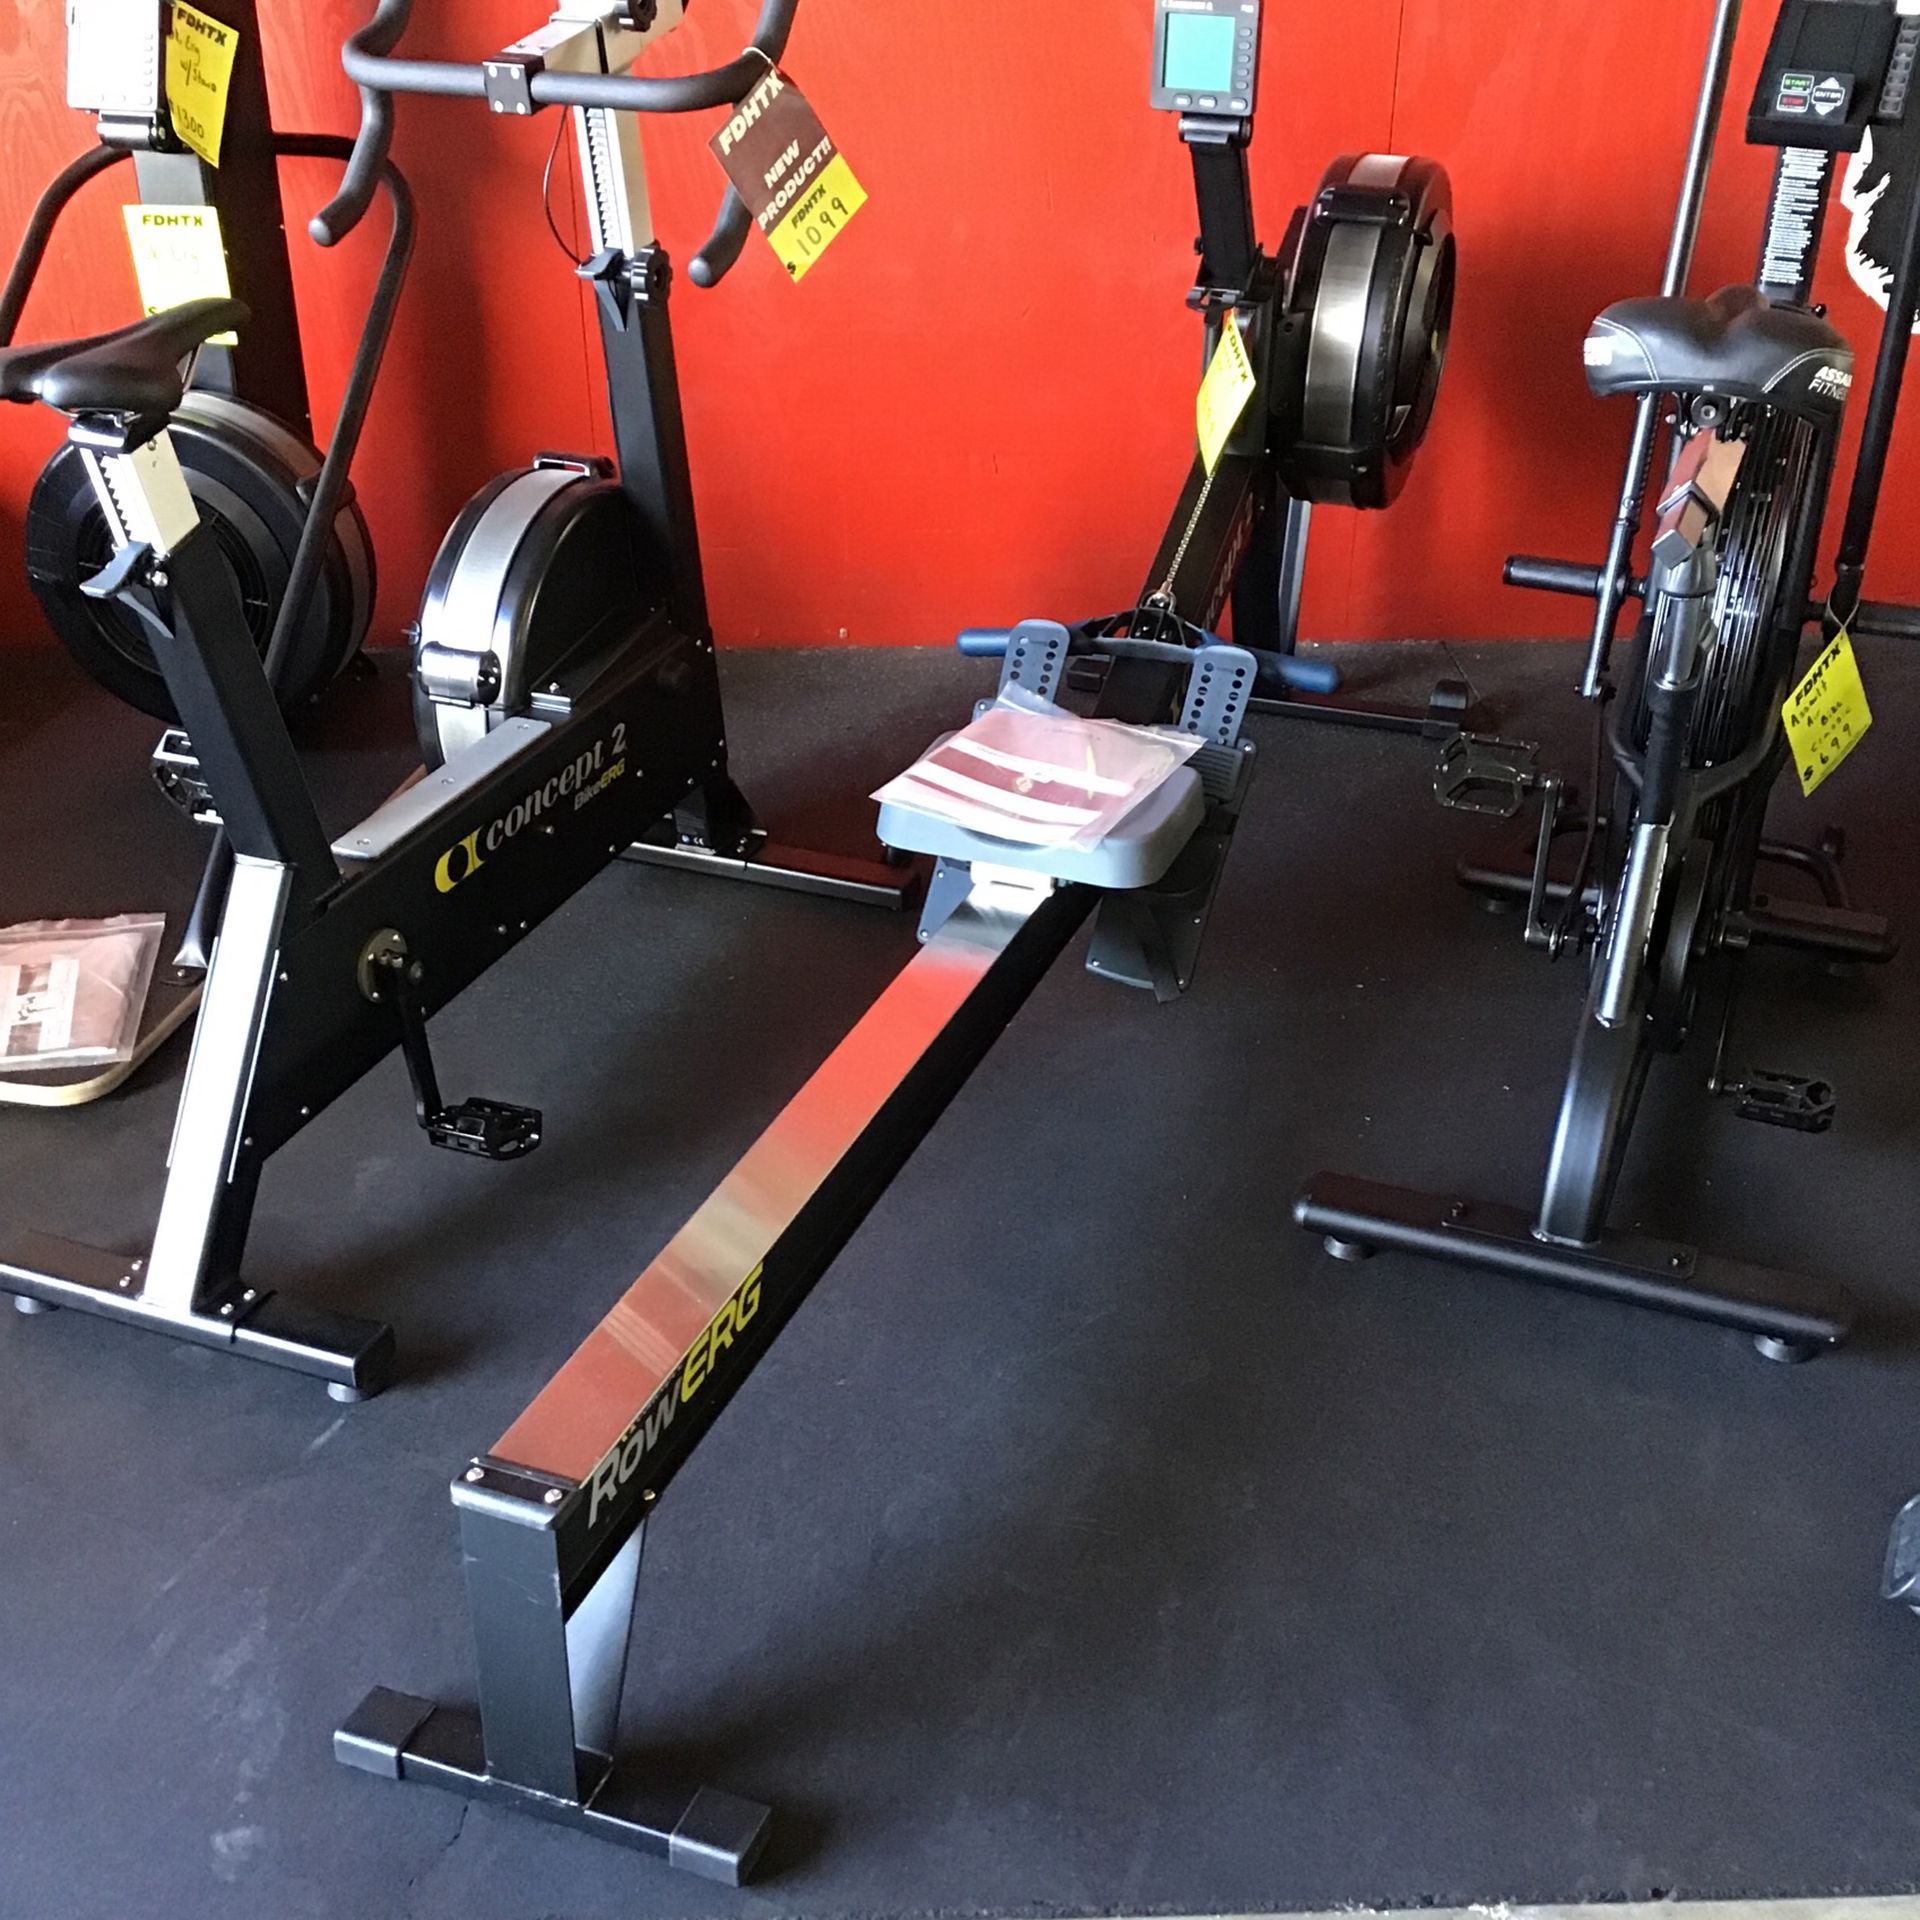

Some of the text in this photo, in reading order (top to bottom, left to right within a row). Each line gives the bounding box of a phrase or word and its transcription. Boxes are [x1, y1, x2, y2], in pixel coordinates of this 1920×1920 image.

[177, 7, 228, 48] FDHTX
[718, 69, 784, 156] FDHTX
[757, 136, 832, 231] PRODUCT!!
[763, 139, 800, 189] NEW
[142, 214, 204, 227] FDHTX
[791, 184, 826, 229] FDHTX
[1227, 323, 1249, 384] FDHTX
[1795, 643, 1841, 706] FDHTX
[486, 722, 627, 851] concept 2
